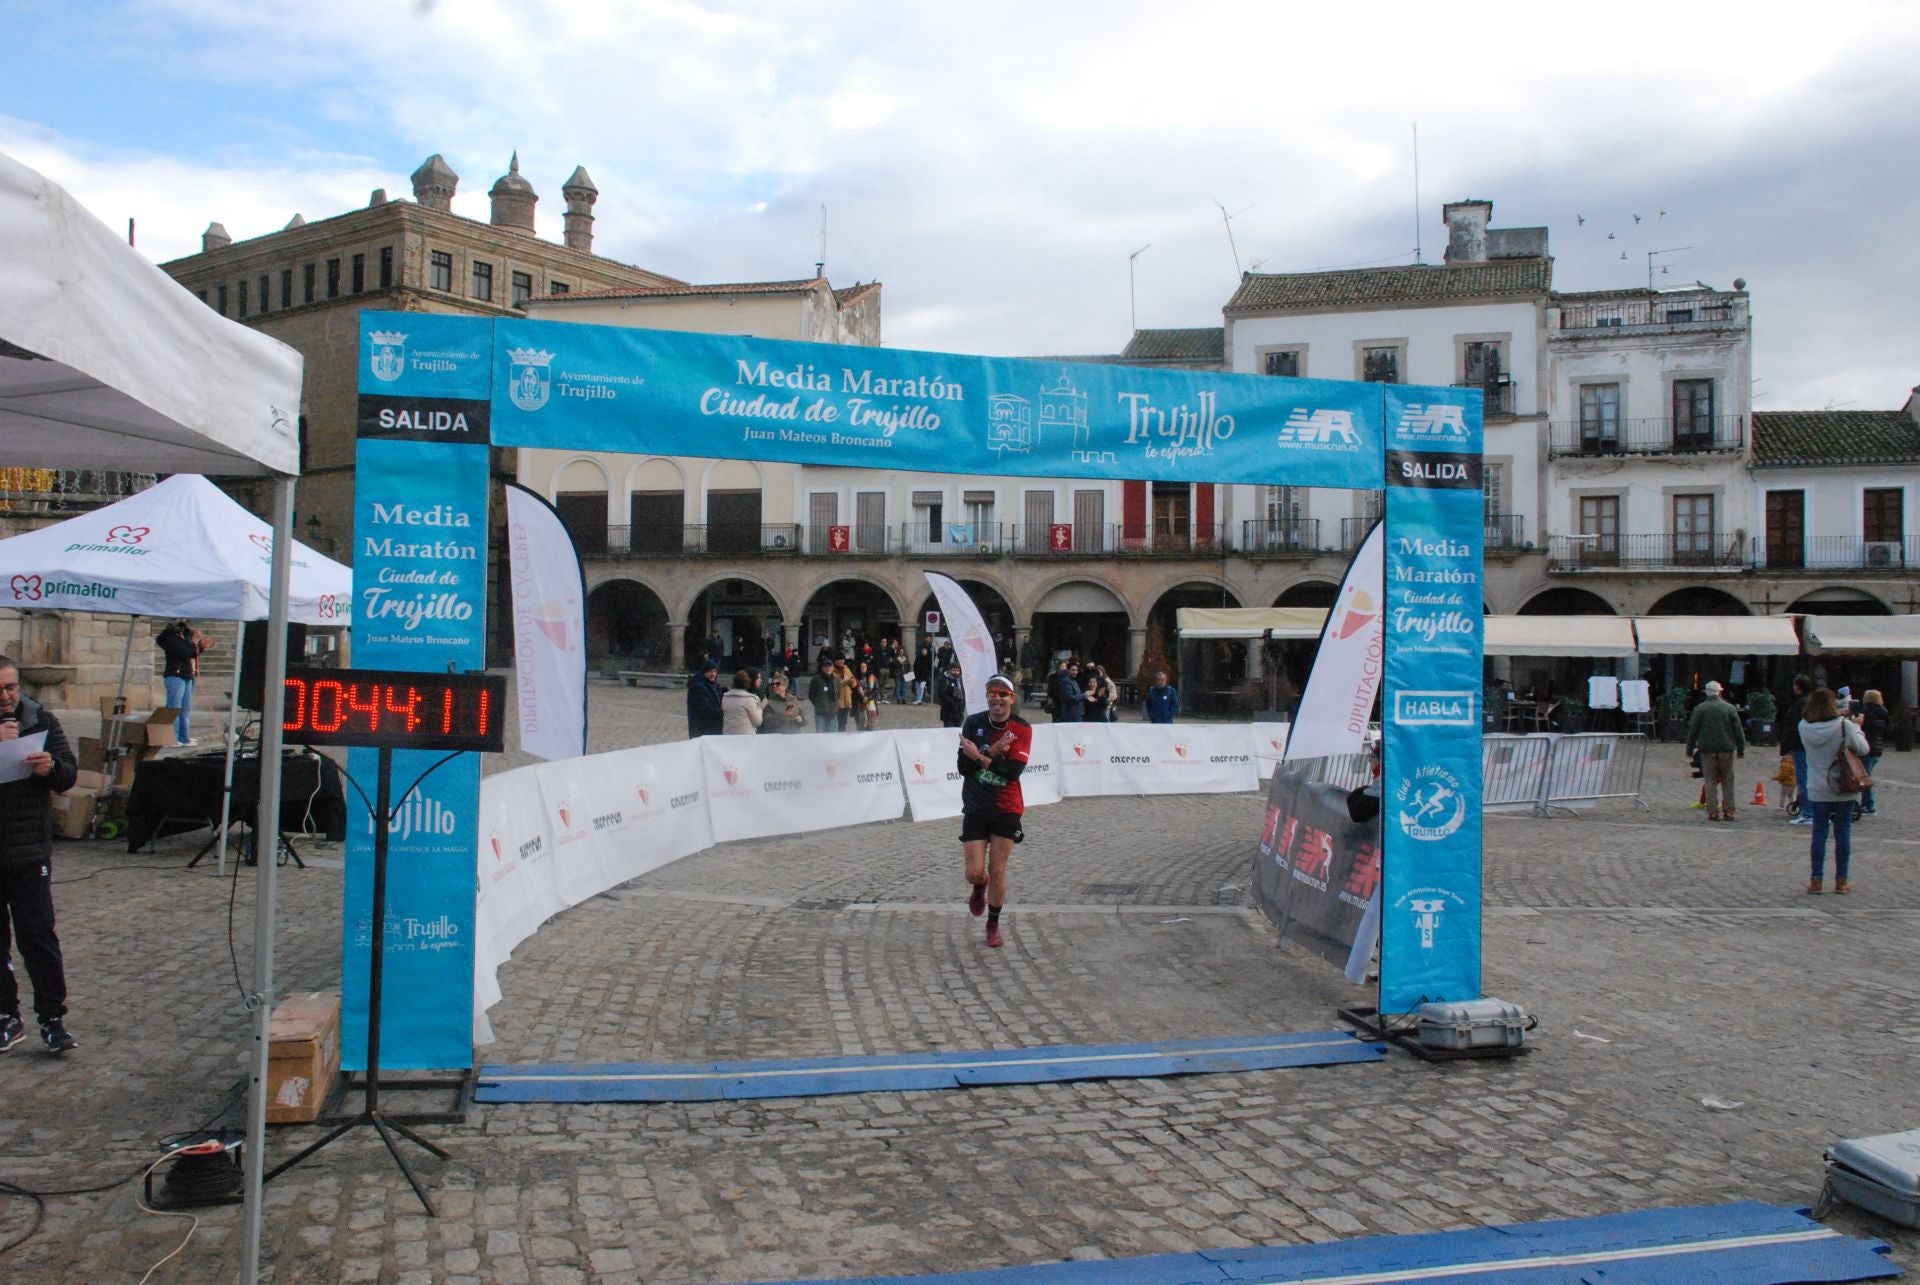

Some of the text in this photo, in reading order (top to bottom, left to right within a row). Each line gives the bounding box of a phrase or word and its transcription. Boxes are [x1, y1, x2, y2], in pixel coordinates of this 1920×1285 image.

[411, 349, 480, 359] Ayuntamiento de
[410, 359, 457, 373] Trujillo
[559, 371, 645, 385] Ayuntamiento de
[735, 359, 965, 401] Media Maratón
[557, 383, 616, 401] Trujillo
[379, 408, 469, 432] SALIDA
[699, 387, 941, 438] Ciudad de Trujillo
[1117, 390, 1236, 450] Trujillo
[743, 426, 893, 448] Juan Mateos Broncano
[1278, 440, 1360, 453] www.musicrun.es
[1145, 439, 1158, 458] te
[1402, 461, 1468, 480] SALIDA
[372, 503, 471, 528] Media
[65, 543, 151, 556] primaflor
[364, 537, 477, 560] Maratón
[1399, 537, 1471, 557] Media
[378, 567, 459, 585] Ciudad de
[1394, 565, 1478, 584] Maratón
[44, 581, 118, 599] primaflor
[1403, 590, 1463, 605] Ciudad de
[363, 587, 473, 630] Trujillo
[1393, 607, 1474, 642] Trujillo
[367, 633, 388, 644] Juan
[426, 634, 470, 645] Broncano
[1406, 701, 1463, 716] HABLA
[1416, 765, 1460, 788] Atletismo
[1397, 777, 1411, 801] Club
[403, 915, 458, 940] Trujillo
